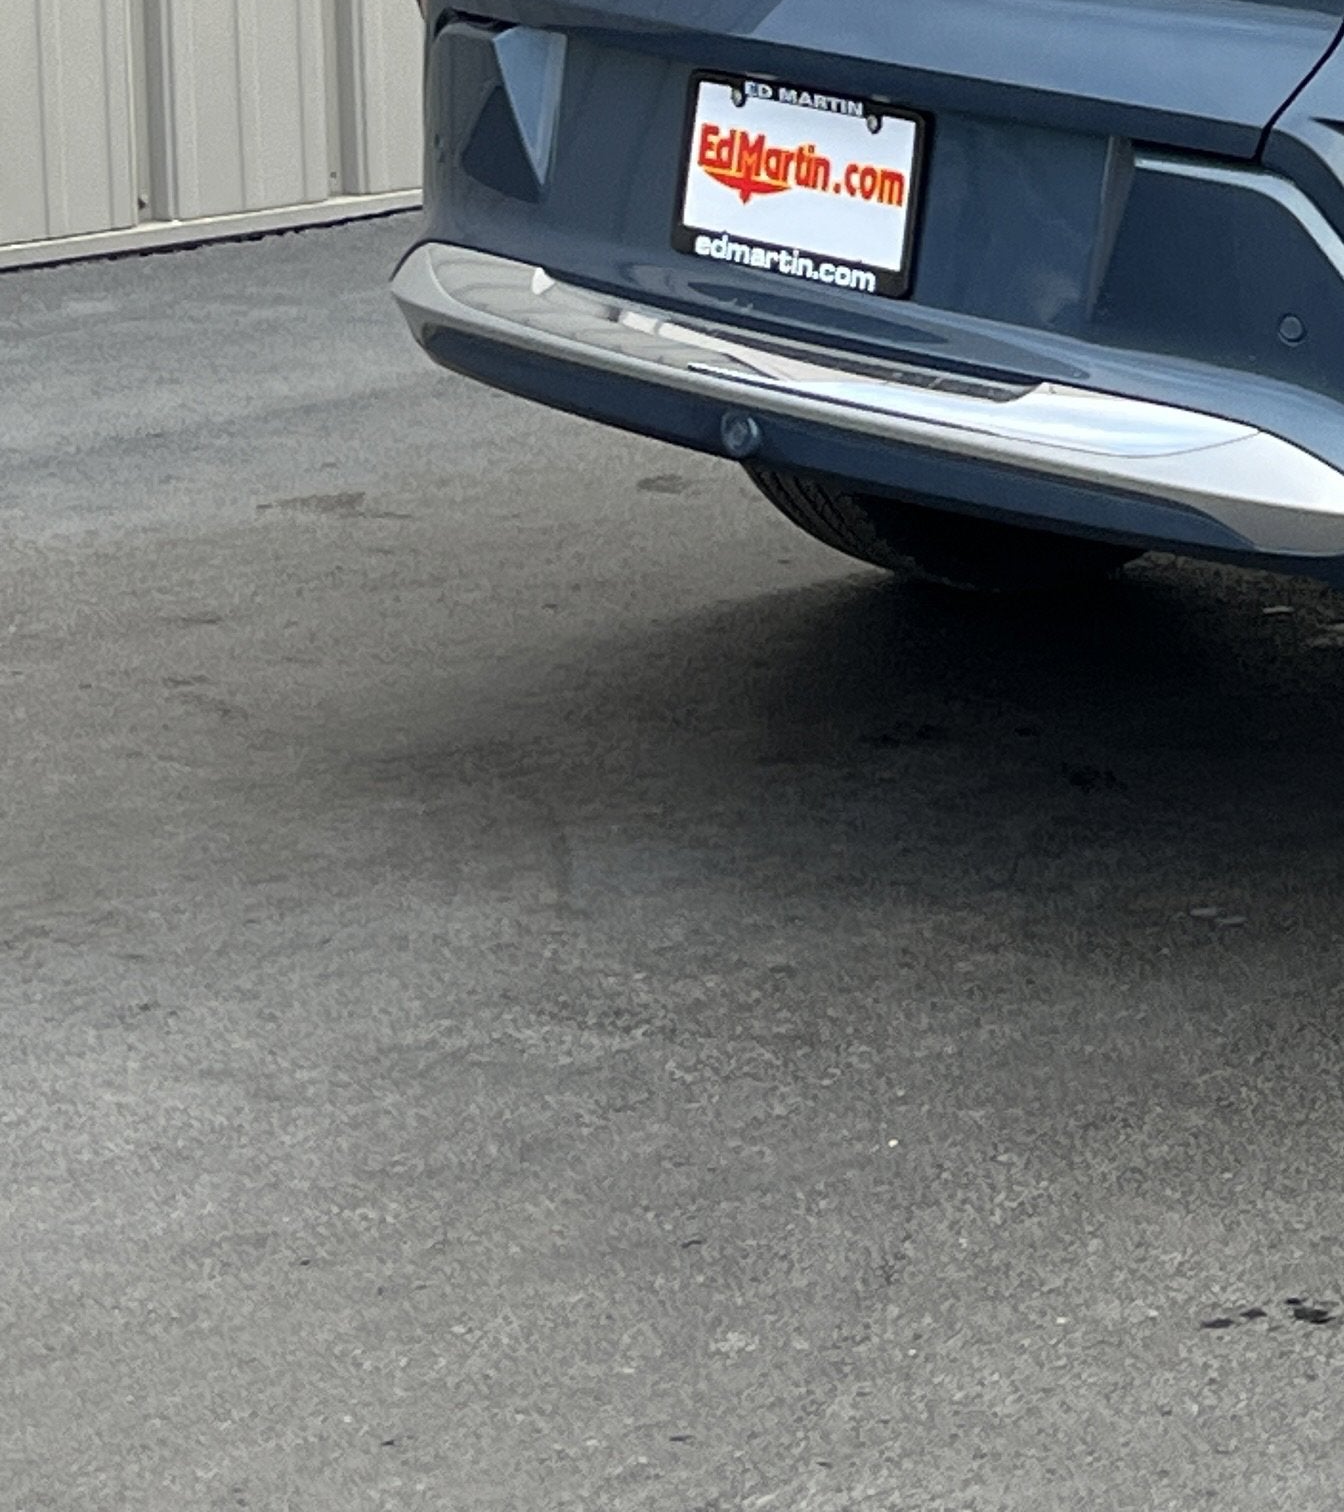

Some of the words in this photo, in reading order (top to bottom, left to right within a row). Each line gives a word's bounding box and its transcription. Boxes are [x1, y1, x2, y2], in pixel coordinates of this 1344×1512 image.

[745, 81, 773, 100] ED
[778, 87, 865, 119] MARTIN
[694, 233, 876, 293] edmartin.com
